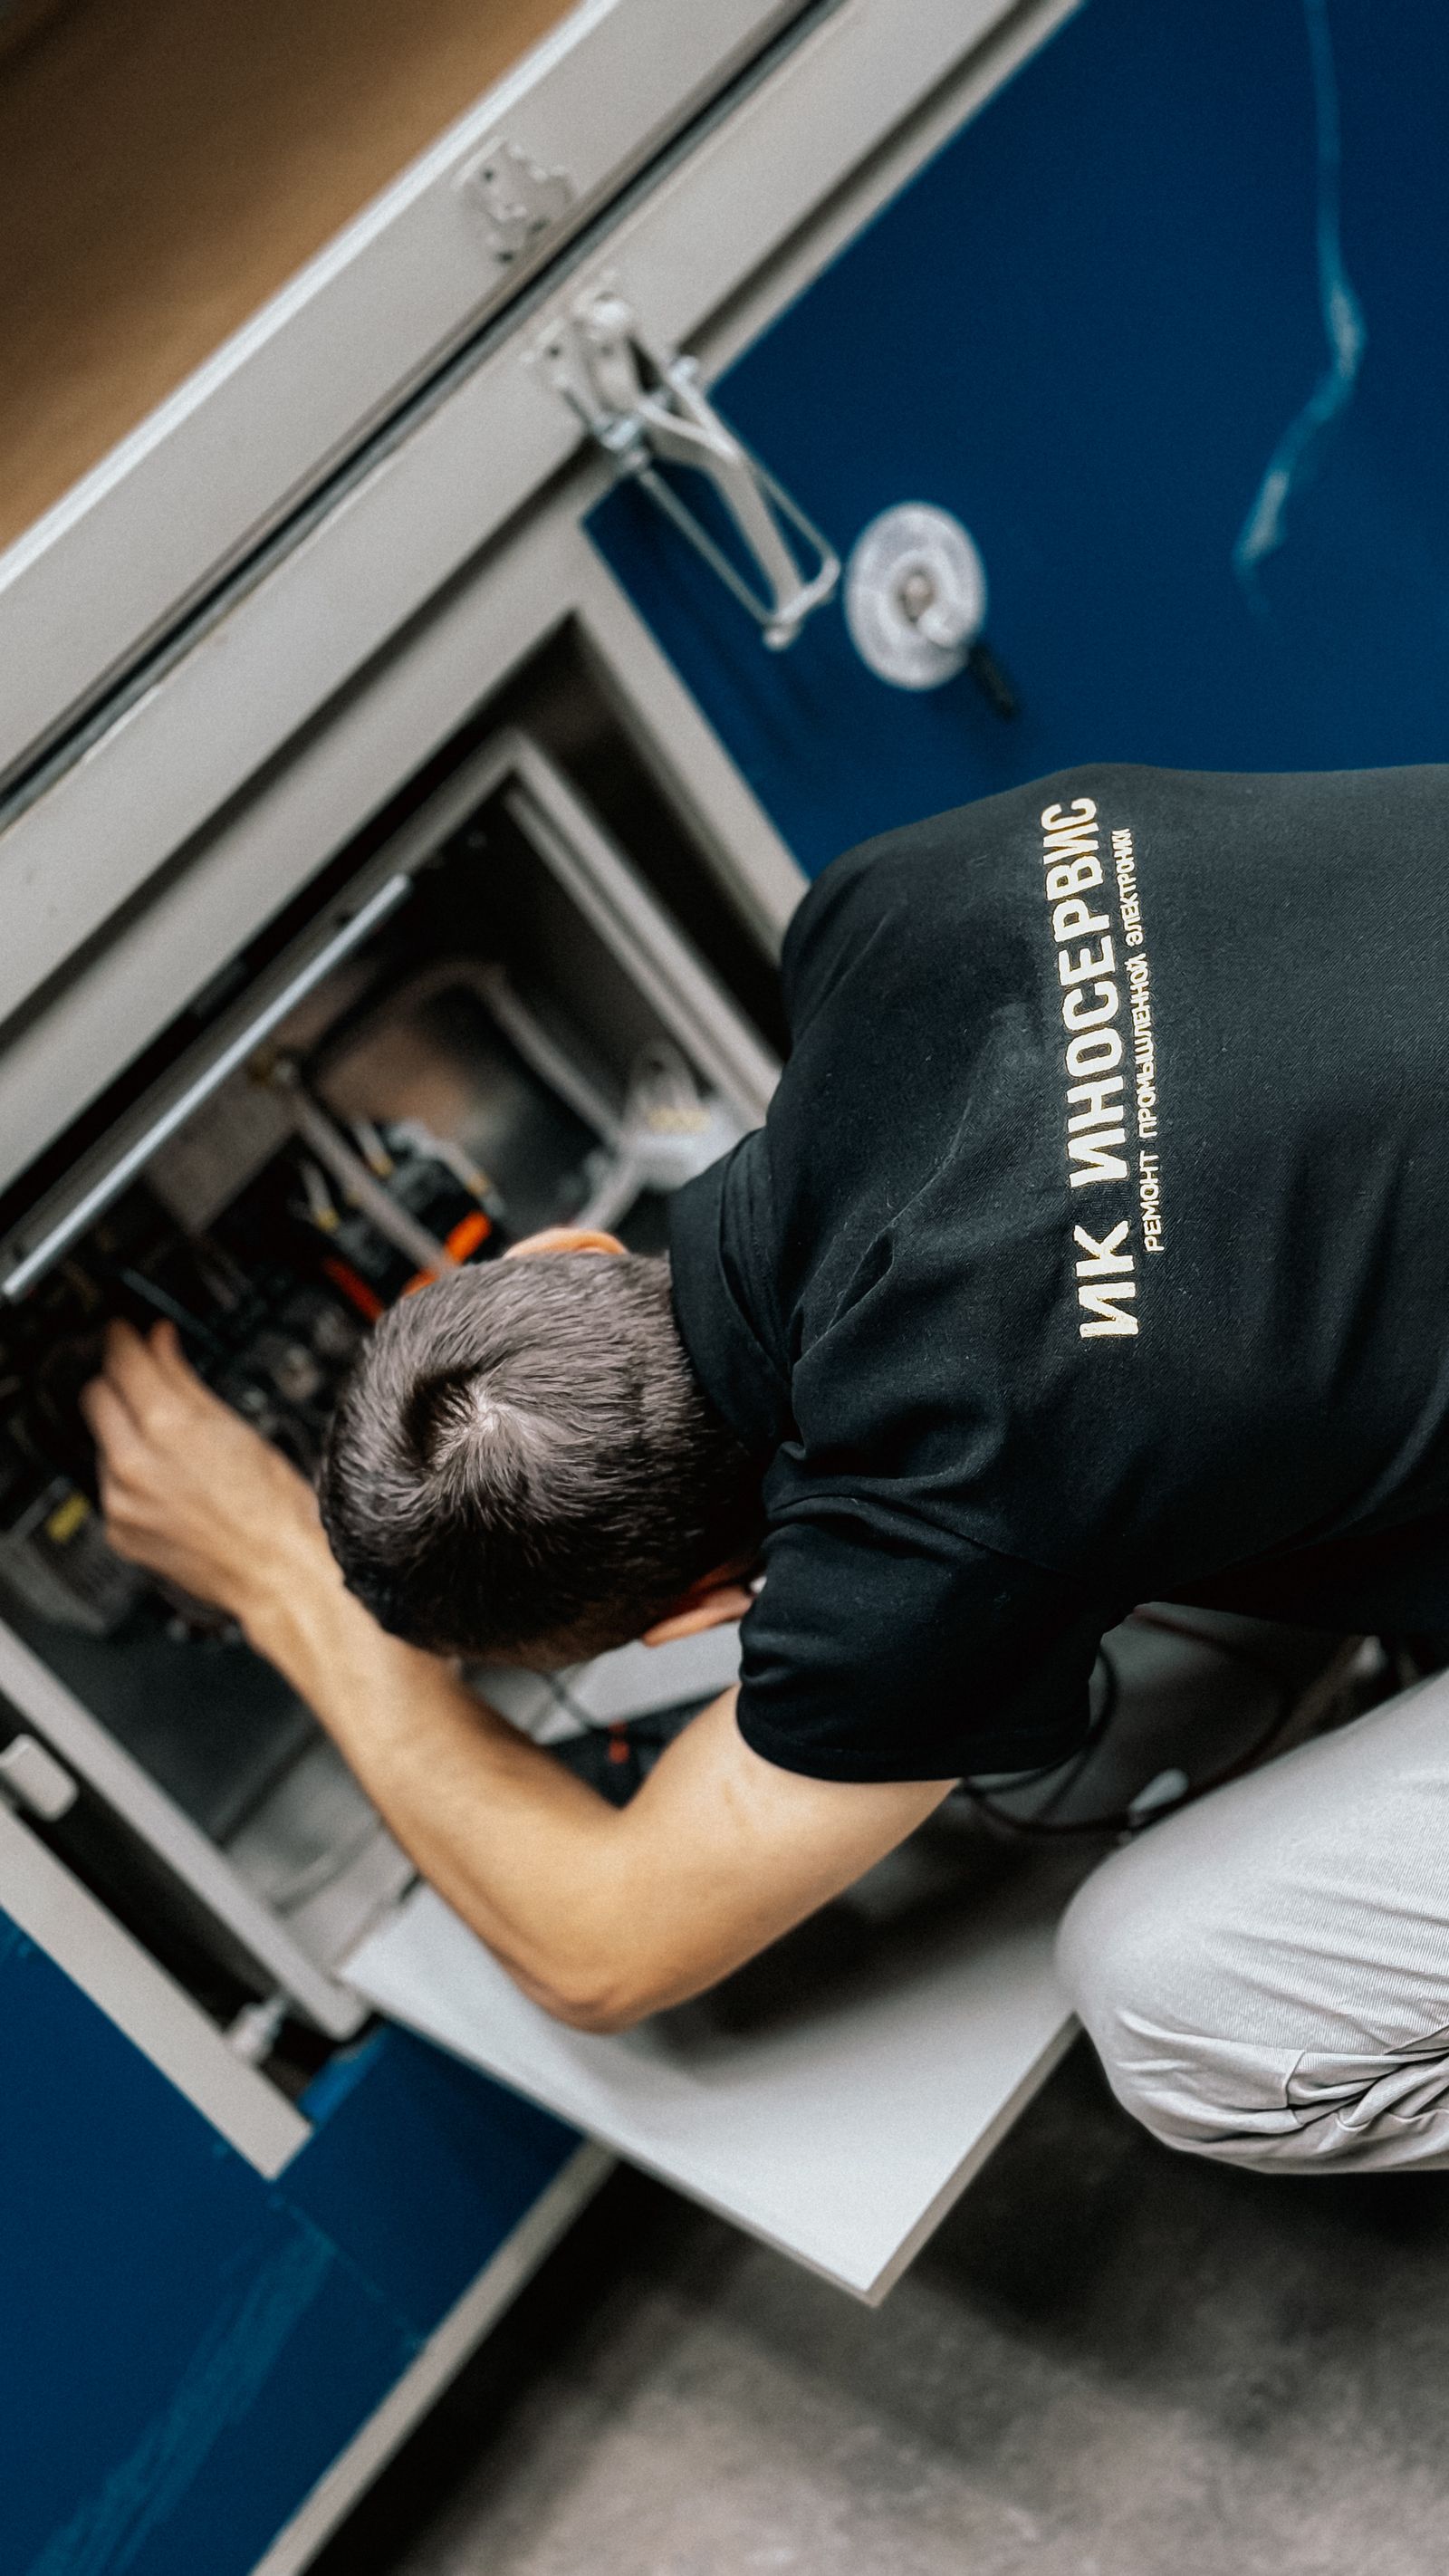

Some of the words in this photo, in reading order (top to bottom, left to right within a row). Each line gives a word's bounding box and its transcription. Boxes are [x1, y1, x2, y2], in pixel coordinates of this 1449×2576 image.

[1112, 828, 1144, 947] ЭЛЕКТРОНИКИ
[1041, 798, 1128, 1187] ИНОСЕРВИС
[1125, 953, 1157, 1139] ПРОМЫШЛЕННОЙ
[1139, 1151, 1165, 1252] РЕМОНТ
[1073, 1220, 1138, 1338] ИК
